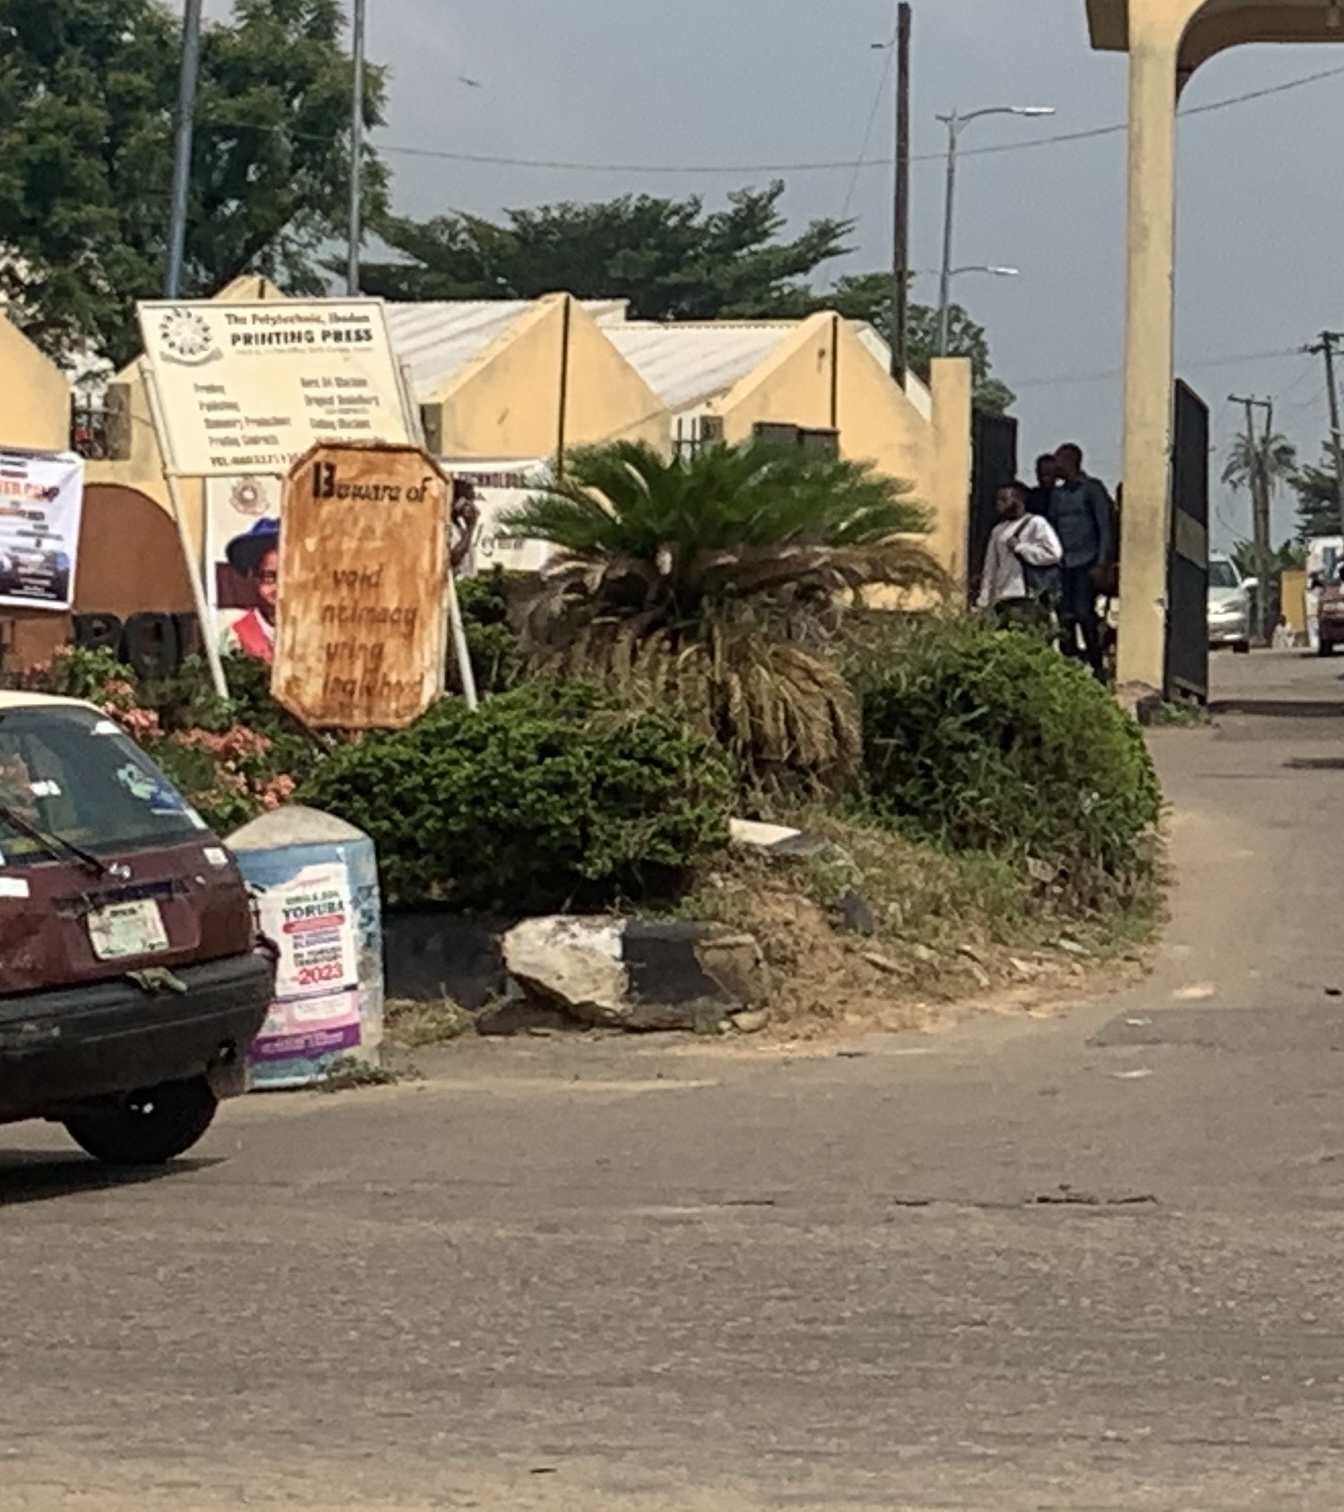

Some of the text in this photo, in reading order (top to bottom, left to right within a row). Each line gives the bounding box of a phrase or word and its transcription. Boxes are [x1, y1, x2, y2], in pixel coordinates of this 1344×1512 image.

[224, 313, 247, 325] The
[230, 327, 373, 346] PRINTING PRESS
[312, 460, 433, 502] Beware of
[281, 899, 345, 922] YORUBA
[298, 962, 344, 985] 2023
